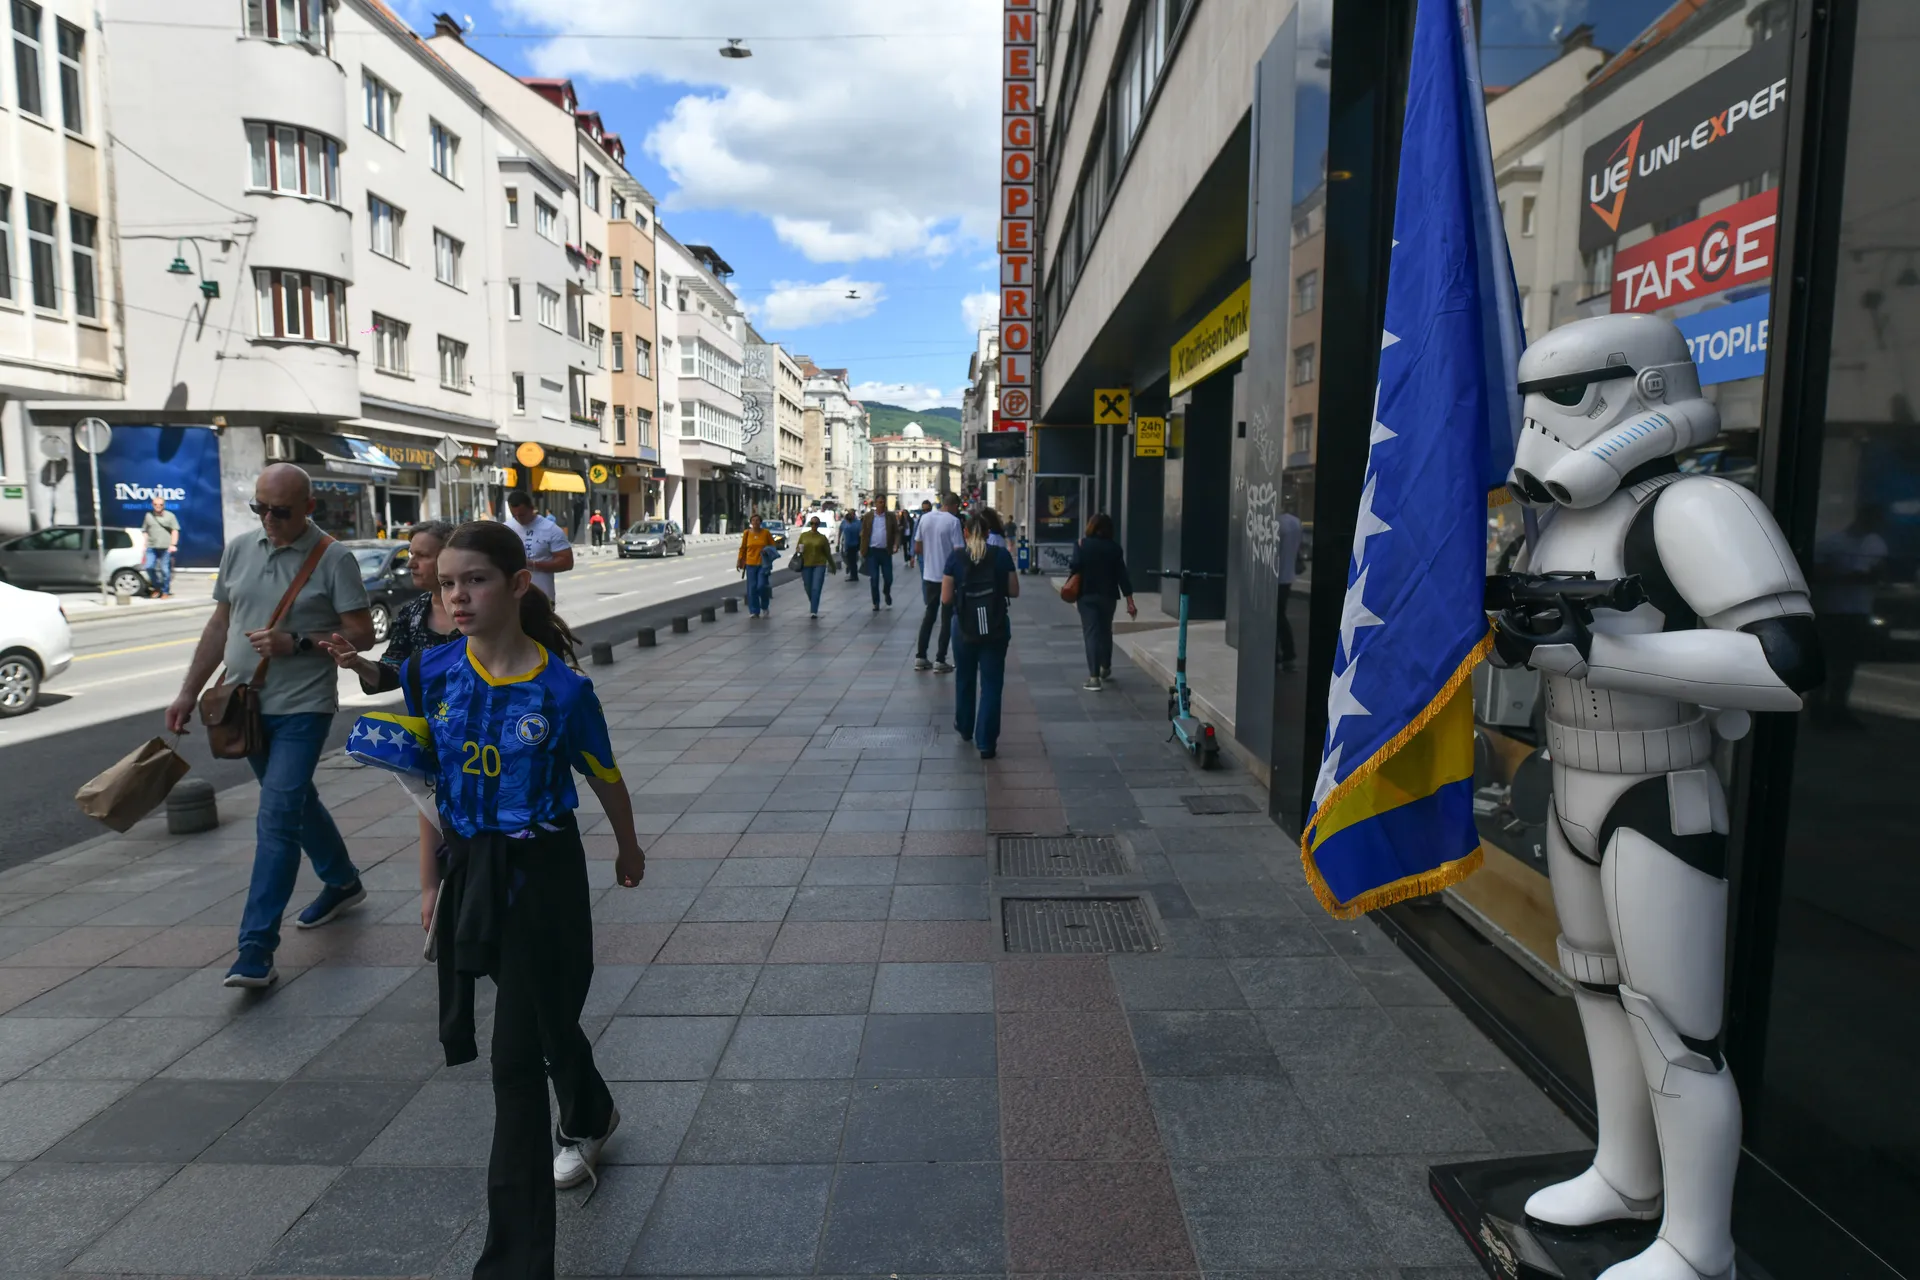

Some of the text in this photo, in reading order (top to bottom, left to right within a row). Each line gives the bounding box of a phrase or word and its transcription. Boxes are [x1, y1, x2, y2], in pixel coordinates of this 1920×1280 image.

[1003, 0, 1033, 384] NERGOPETROL
[1184, 299, 1248, 375] Raiffeisen Bank
[1140, 421, 1162, 432] 24h
[114, 483, 186, 500] iNovine
[461, 740, 501, 778] 20
